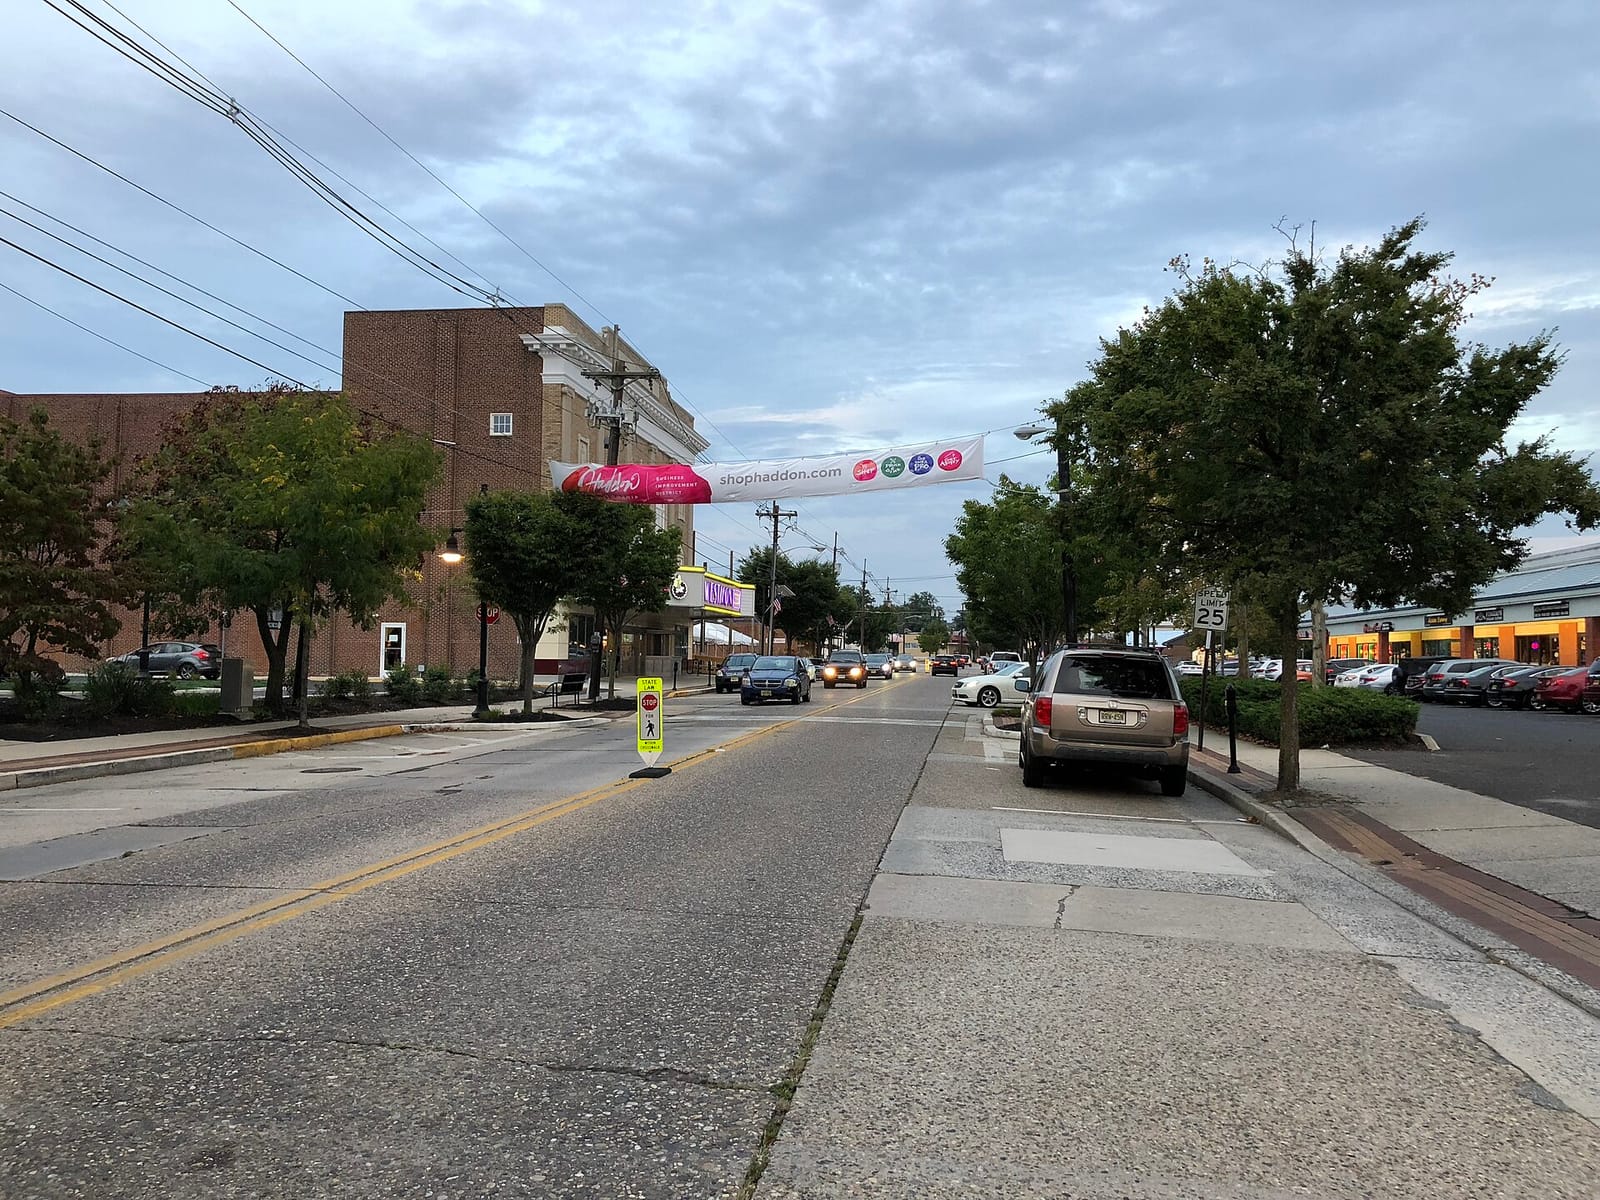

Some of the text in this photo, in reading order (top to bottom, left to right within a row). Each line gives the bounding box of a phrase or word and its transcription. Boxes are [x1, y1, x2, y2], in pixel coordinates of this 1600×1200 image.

[577, 468, 640, 493] Haddon
[719, 466, 842, 486] shophaddon.com
[1198, 590, 1227, 598] SPEED
[1201, 599, 1223, 607] LIMIT
[477, 607, 498, 617] SOP
[1197, 608, 1224, 626] 25
[642, 698, 657, 706] STOP
